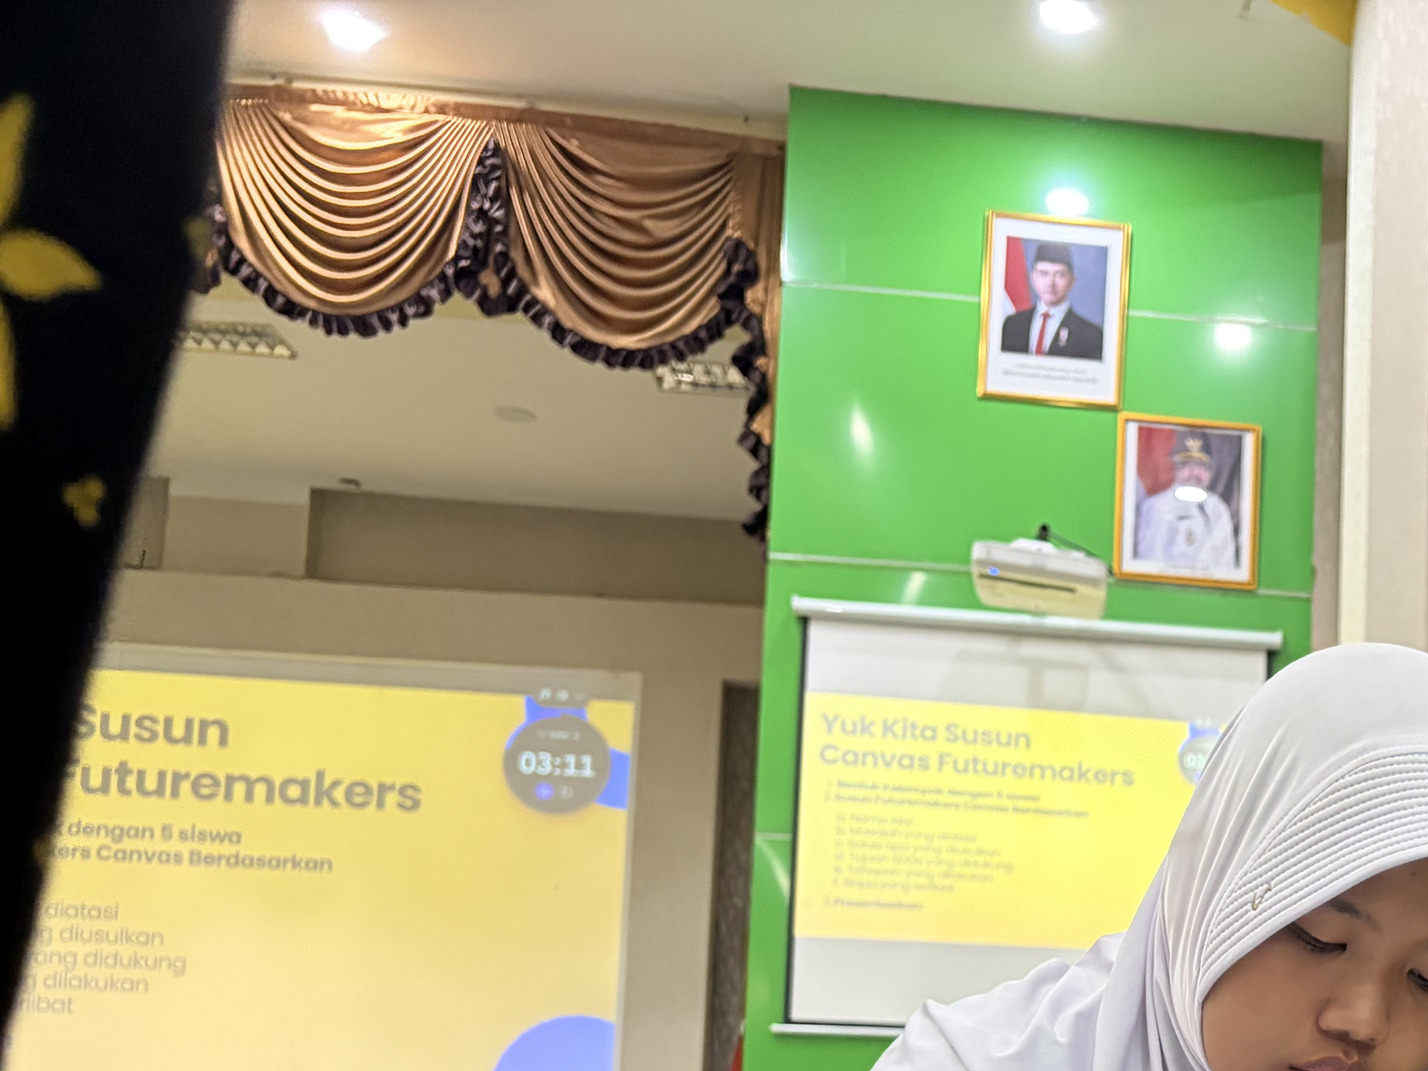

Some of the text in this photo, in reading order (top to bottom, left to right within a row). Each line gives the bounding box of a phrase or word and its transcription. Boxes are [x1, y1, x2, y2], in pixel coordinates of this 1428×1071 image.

[75, 703, 229, 748] Susun
[822, 712, 1031, 750] Yuk Kita Susun
[518, 751, 596, 778] 03:11
[819, 744, 1135, 786] Canvas Futuremakers
[68, 819, 155, 843] dengan
[178, 824, 242, 846] siswa
[97, 844, 183, 865] Canvas
[189, 849, 333, 873] Berdasarkan
[44, 900, 119, 920] diatasi
[60, 924, 164, 946] diusulkan
[32, 949, 187, 978] ang didukung
[43, 970, 149, 992] dilakukan
